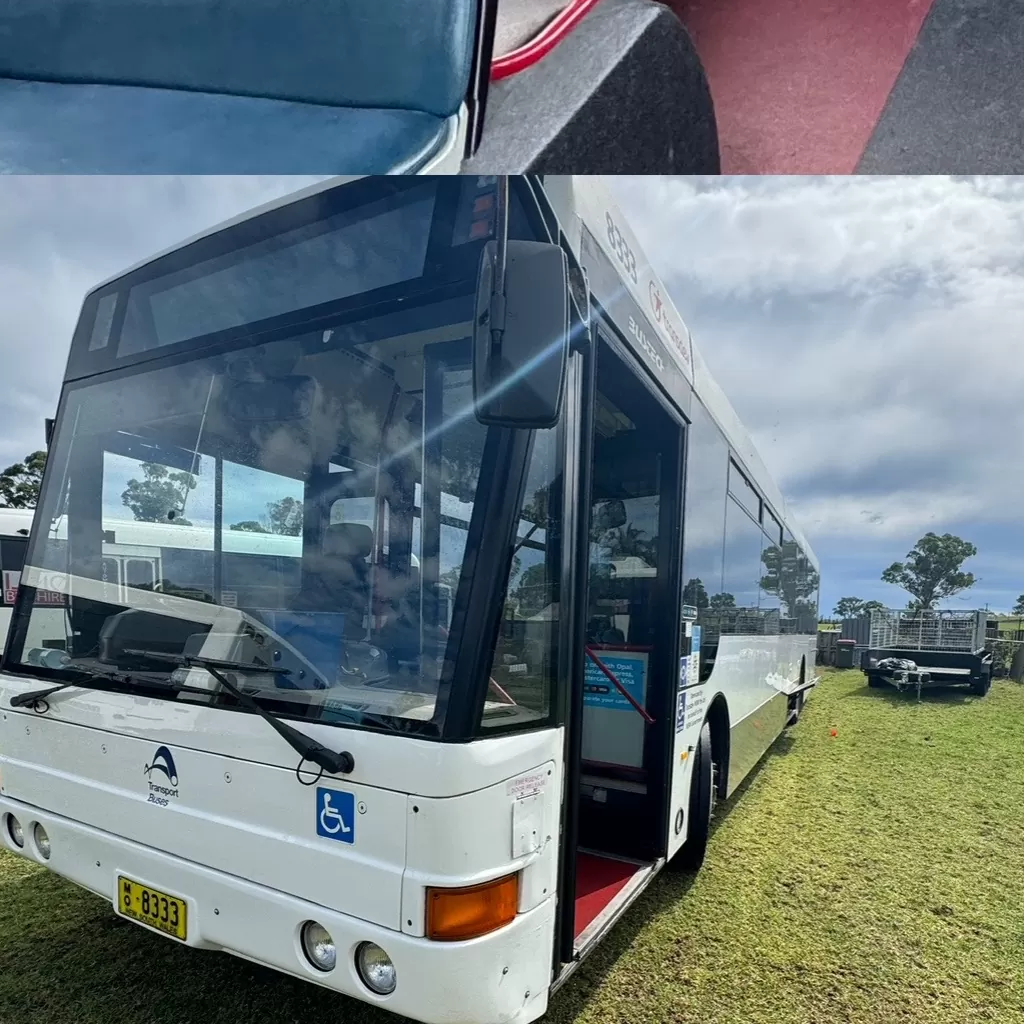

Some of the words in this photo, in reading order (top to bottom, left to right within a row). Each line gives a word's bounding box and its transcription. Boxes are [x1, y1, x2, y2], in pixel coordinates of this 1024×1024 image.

[605, 211, 638, 285] 8333
[147, 793, 170, 807] Buses
[148, 781, 179, 798] Transport
[141, 889, 179, 927] 8333
